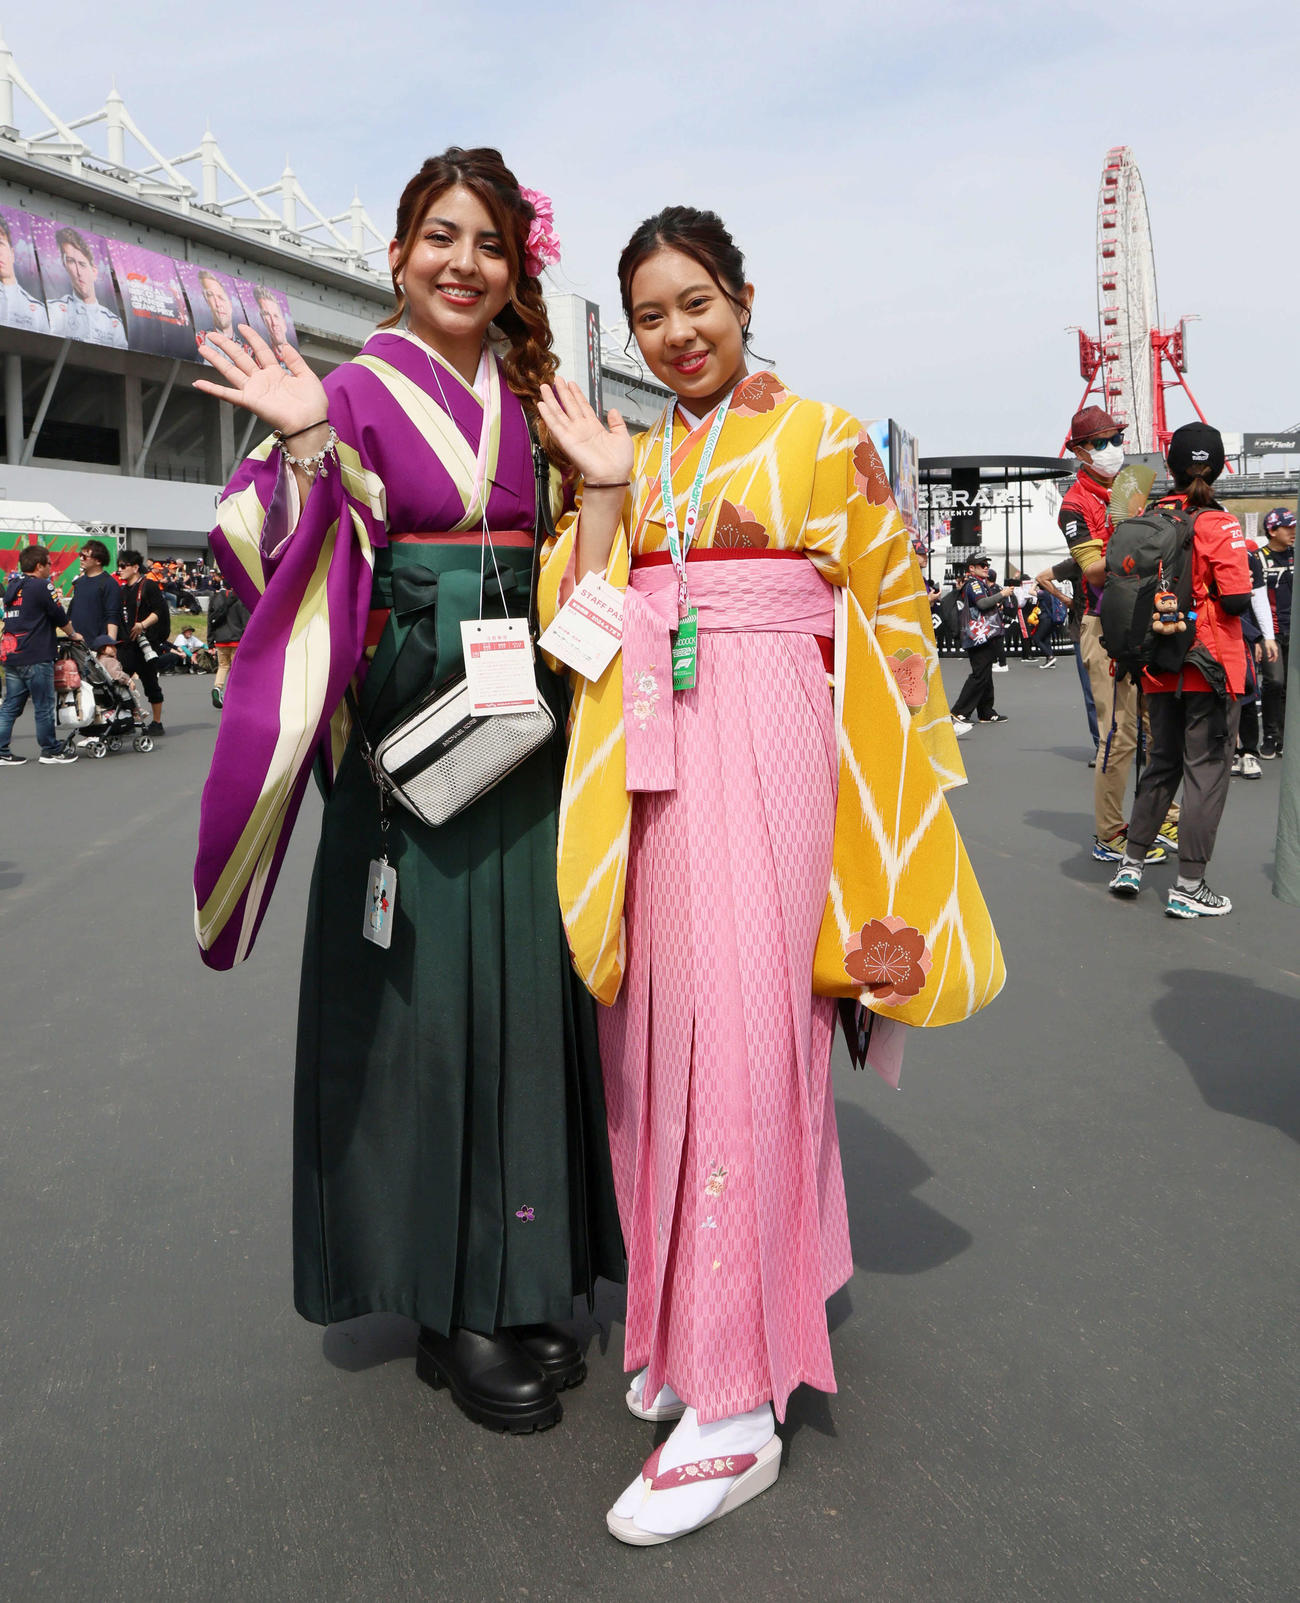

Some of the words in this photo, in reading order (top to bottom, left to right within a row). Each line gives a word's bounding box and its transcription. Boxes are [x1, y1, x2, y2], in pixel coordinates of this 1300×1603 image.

[661, 480, 673, 510] JAPAN
[690, 473, 704, 506] JAPAN
[939, 509, 974, 517] TRENTO
[580, 589, 607, 610] STAFF
[607, 607, 624, 622] PAS
